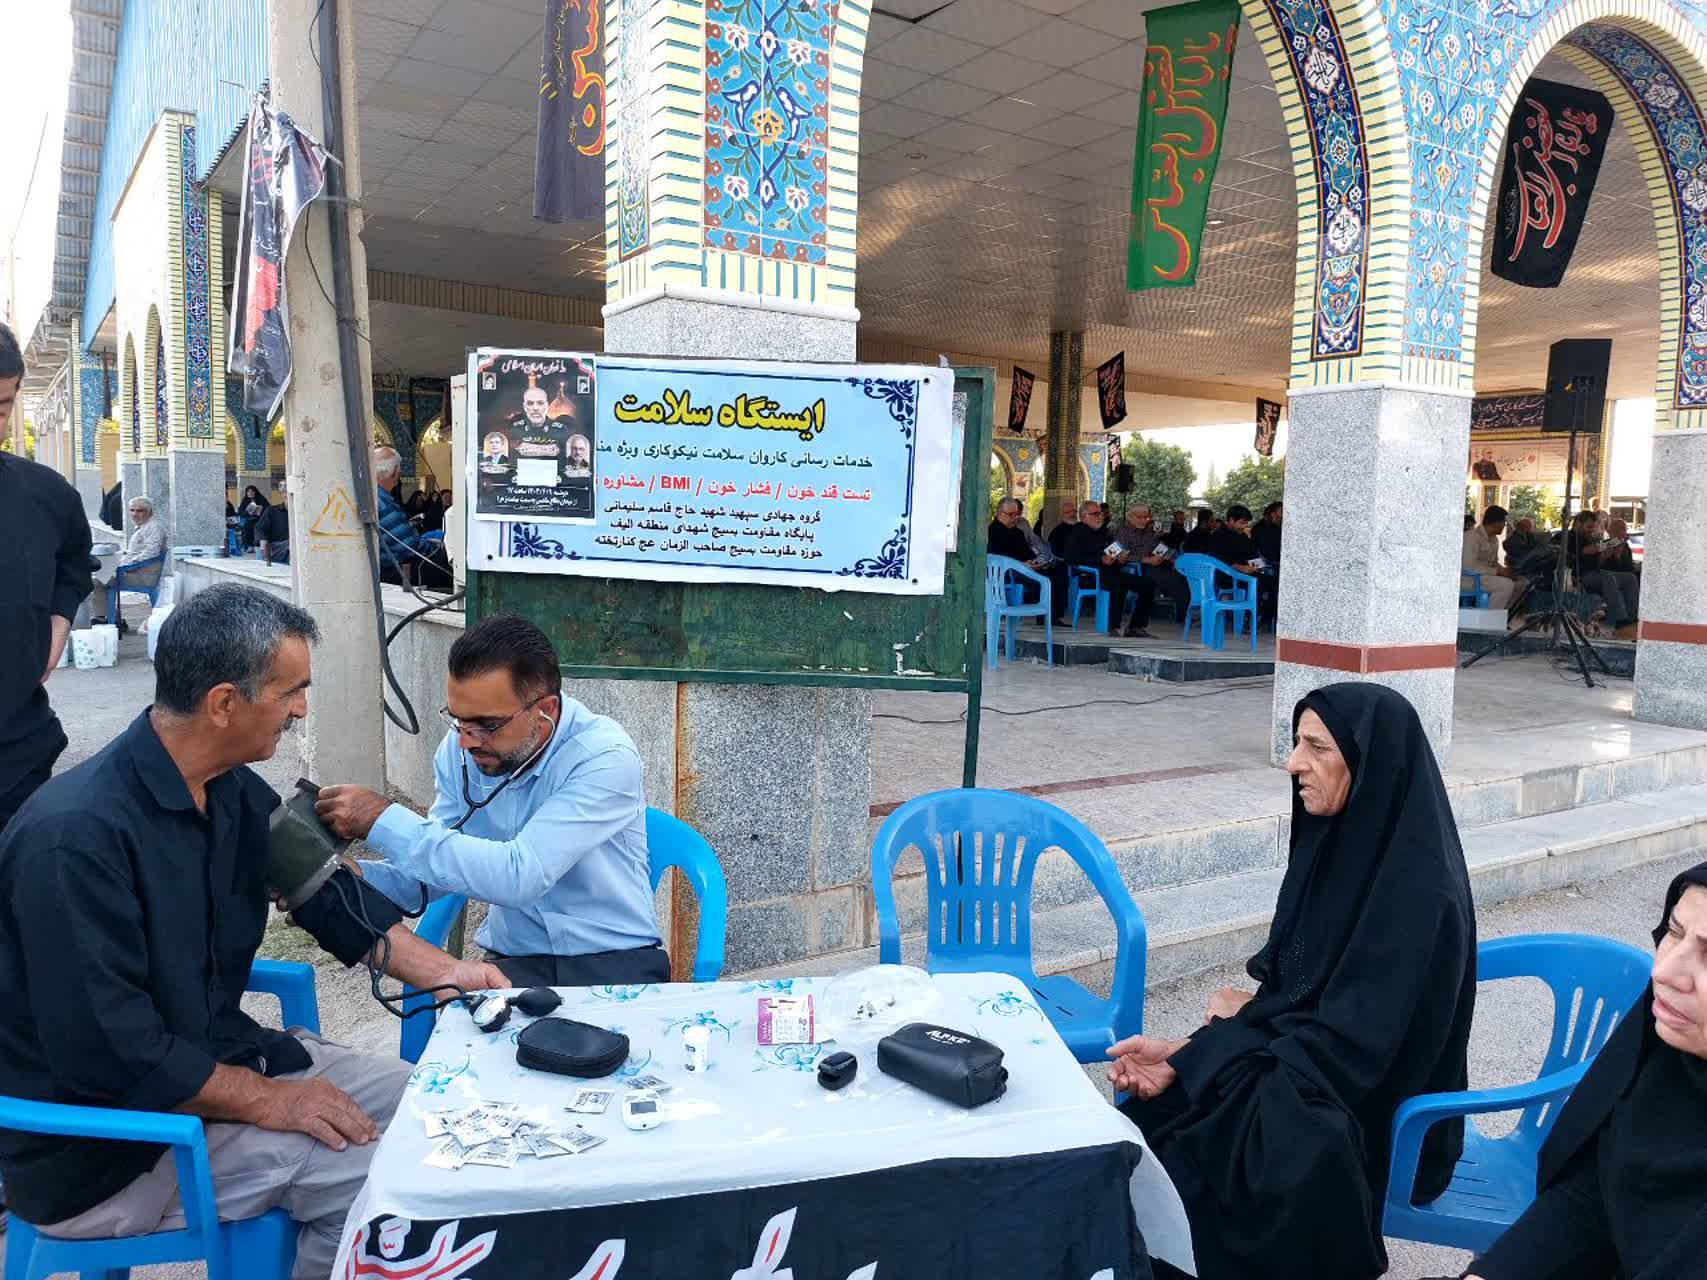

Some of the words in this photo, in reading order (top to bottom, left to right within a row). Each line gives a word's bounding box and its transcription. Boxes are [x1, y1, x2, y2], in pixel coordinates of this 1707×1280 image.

[614, 388, 713, 426] سلامت
[718, 393, 825, 440] ایستگاه
[616, 440, 639, 460] ویژه
[643, 443, 698, 460] نیکوکاری
[702, 447, 745, 461] سلامت
[749, 449, 788, 466] کاروان
[790, 451, 830, 469] رسانی
[832, 455, 873, 468] خدمات
[603, 474, 645, 490] مشاوره
[648, 474, 656, 494] /
[660, 475, 691, 490] BMI
[695, 478, 703, 497] /
[707, 481, 737, 496] خون
[742, 481, 771, 497] فشار
[775, 482, 783, 500] /
[787, 485, 815, 501] خون
[821, 484, 839, 499] قند
[842, 488, 871, 501] تست
[604, 500, 645, 514] سلیمانی
[647, 502, 672, 514] قاسم
[675, 504, 697, 518] حاج
[700, 506, 726, 519] شهید
[728, 508, 760, 522] سپهبد
[762, 509, 796, 522] جهادی
[799, 510, 821, 524] گروه
[610, 518, 633, 531] الیف
[637, 519, 669, 532] منطقه
[672, 522, 709, 535] شهدای
[711, 526, 738, 539] بسیج
[742, 526, 781, 539] مقاومت
[784, 527, 815, 542] پایگاه
[594, 535, 637, 549] کنارتخته
[638, 539, 656, 552] عج
[660, 538, 689, 552] الزمان
[693, 541, 726, 553] صاحب
[728, 544, 757, 557] بسیج
[759, 544, 797, 558] مقاومت
[800, 547, 823, 559] حوزه
